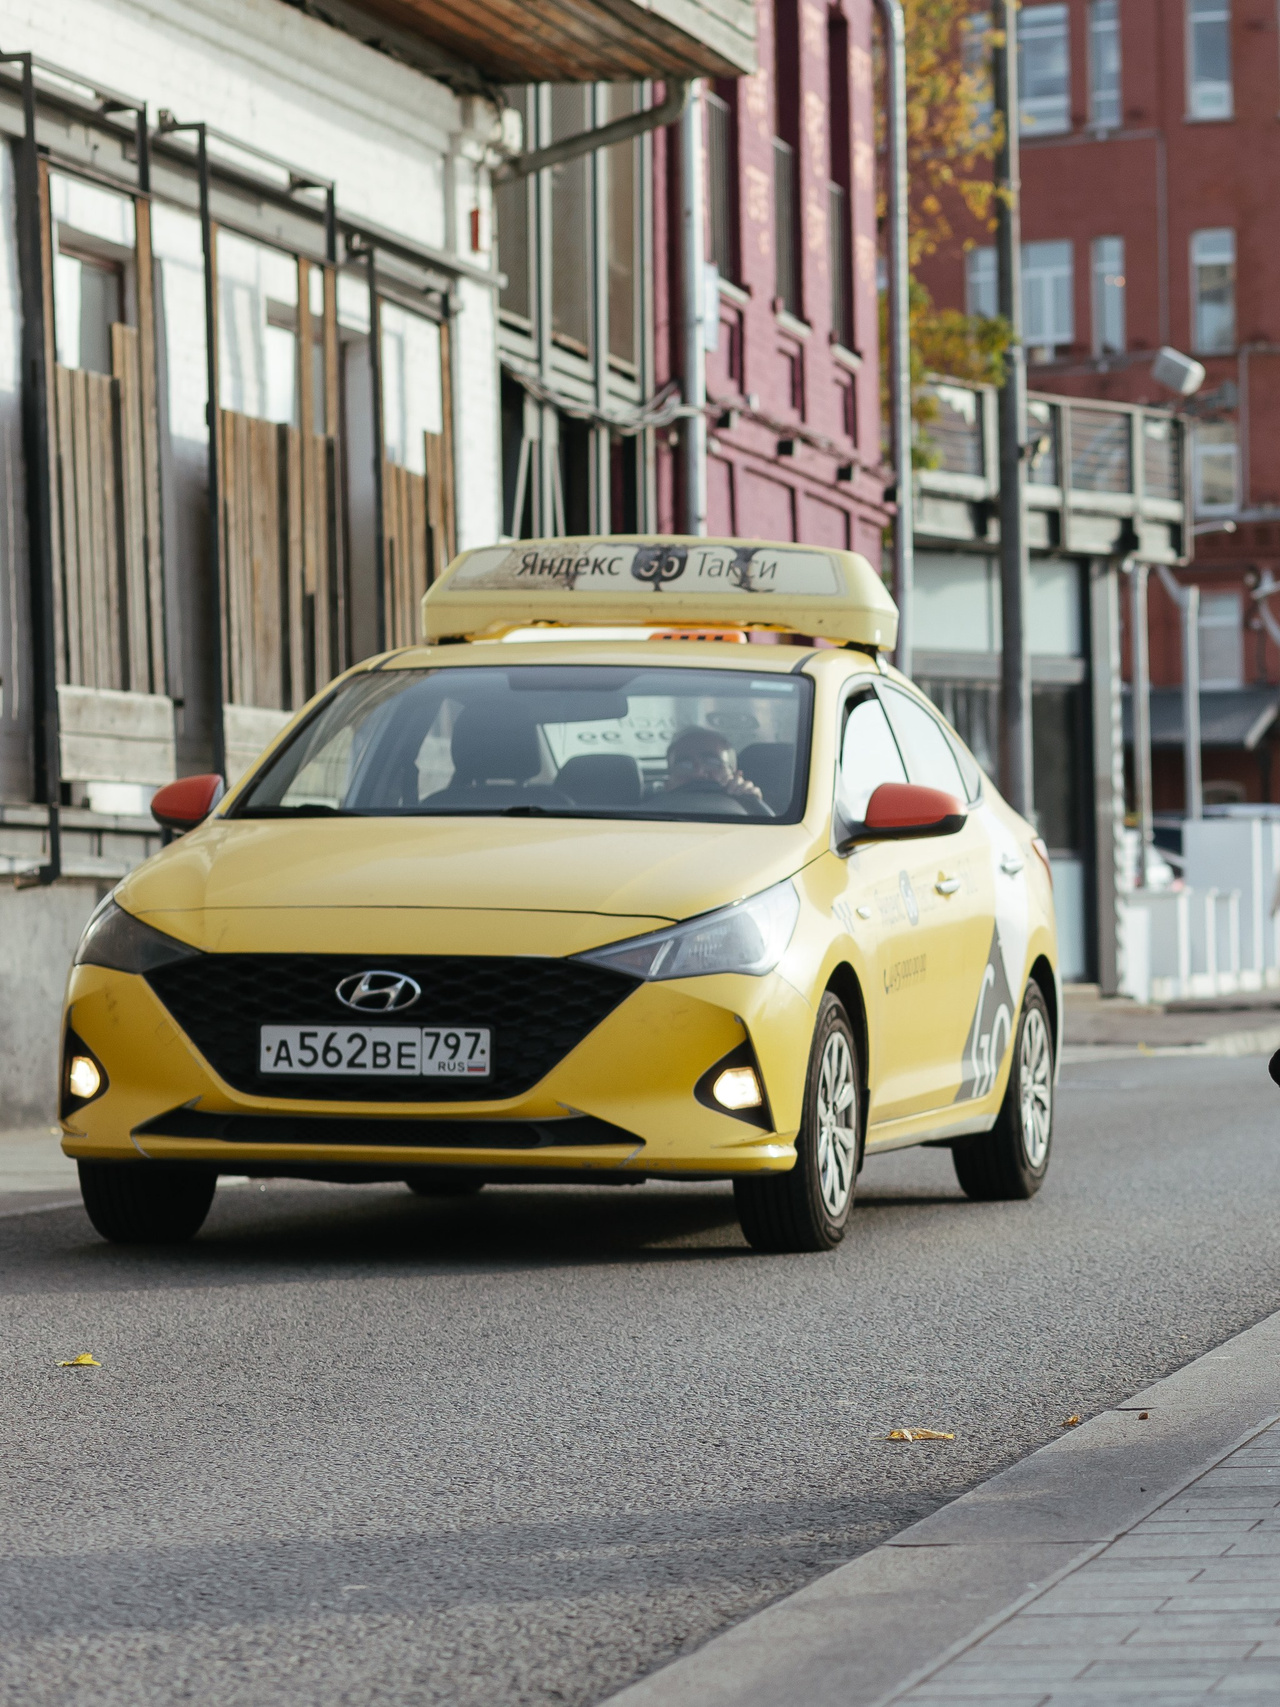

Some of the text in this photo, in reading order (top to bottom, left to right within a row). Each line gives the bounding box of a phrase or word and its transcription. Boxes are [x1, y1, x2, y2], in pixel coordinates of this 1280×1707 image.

[517, 551, 623, 579] Яндекс
[424, 1031, 482, 1060] 797
[437, 1061, 466, 1072] RUS
